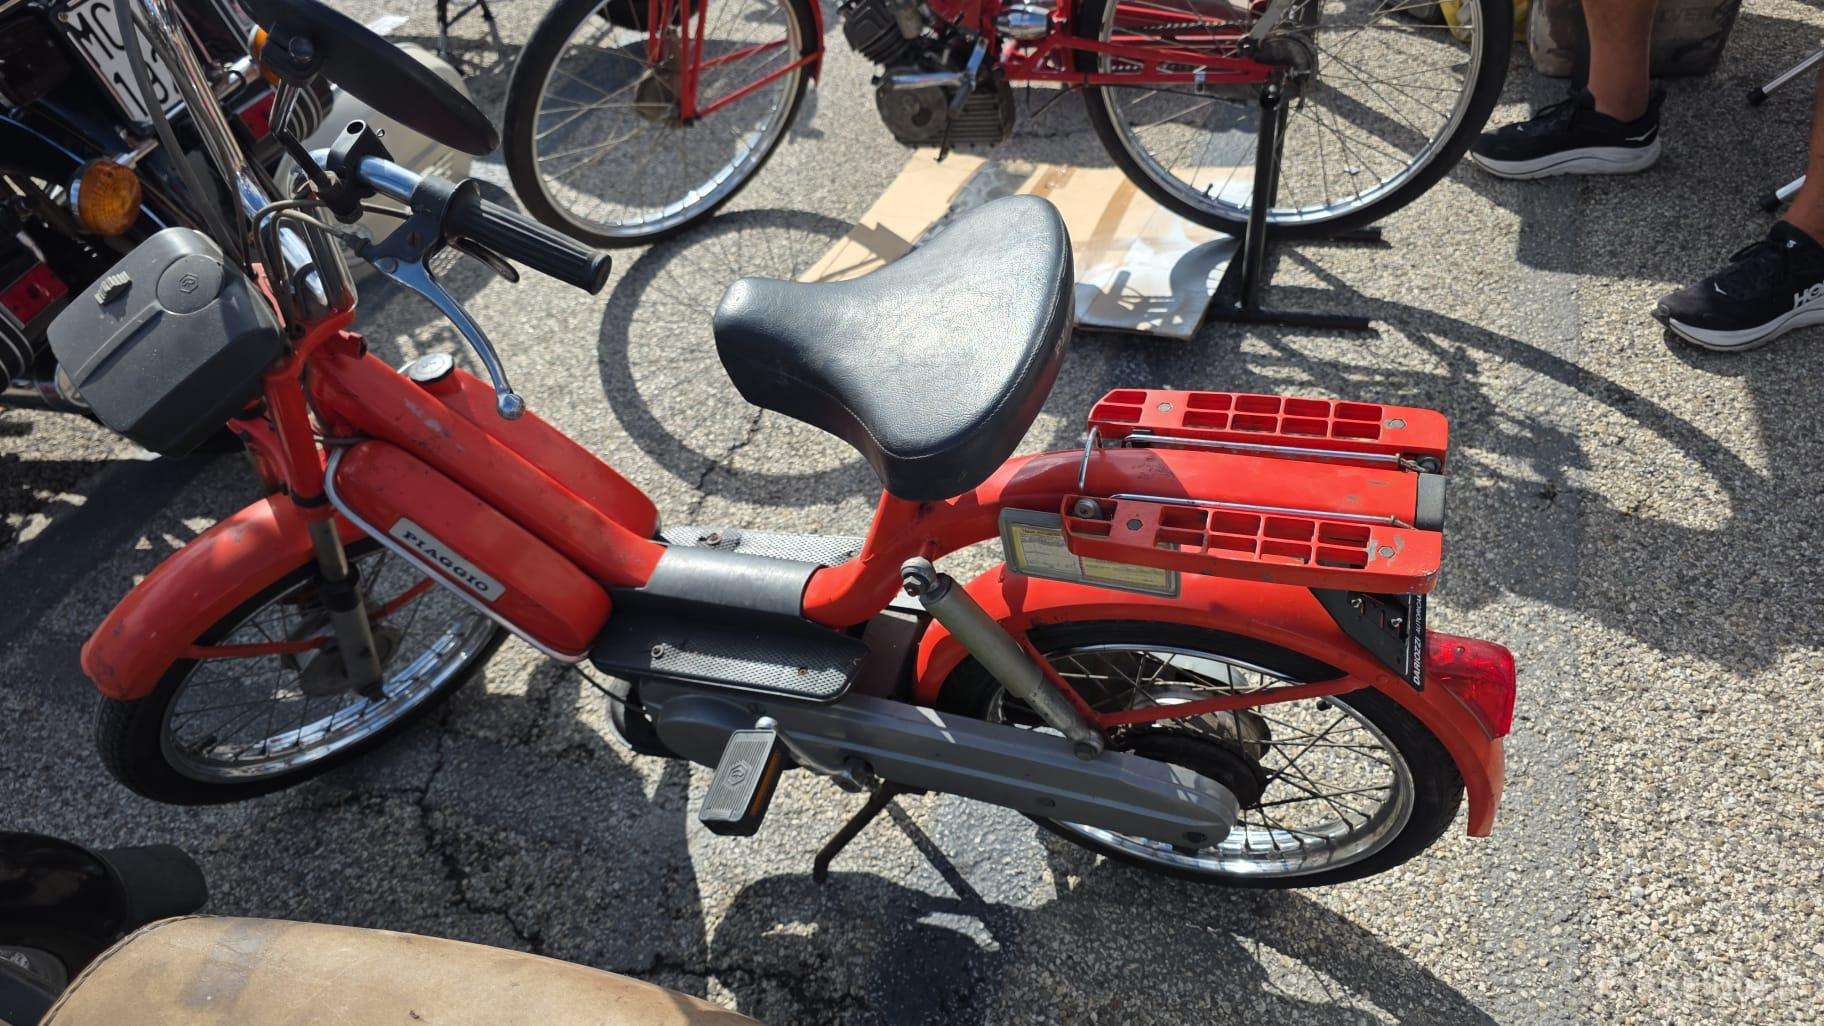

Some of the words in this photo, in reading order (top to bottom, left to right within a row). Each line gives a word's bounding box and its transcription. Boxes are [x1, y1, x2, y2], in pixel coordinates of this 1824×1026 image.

[66, 3, 125, 67] MC
[1792, 280, 1824, 312] HO
[403, 530, 488, 592] PIAGGIO
[1413, 636, 1421, 686] DARIOZZI
